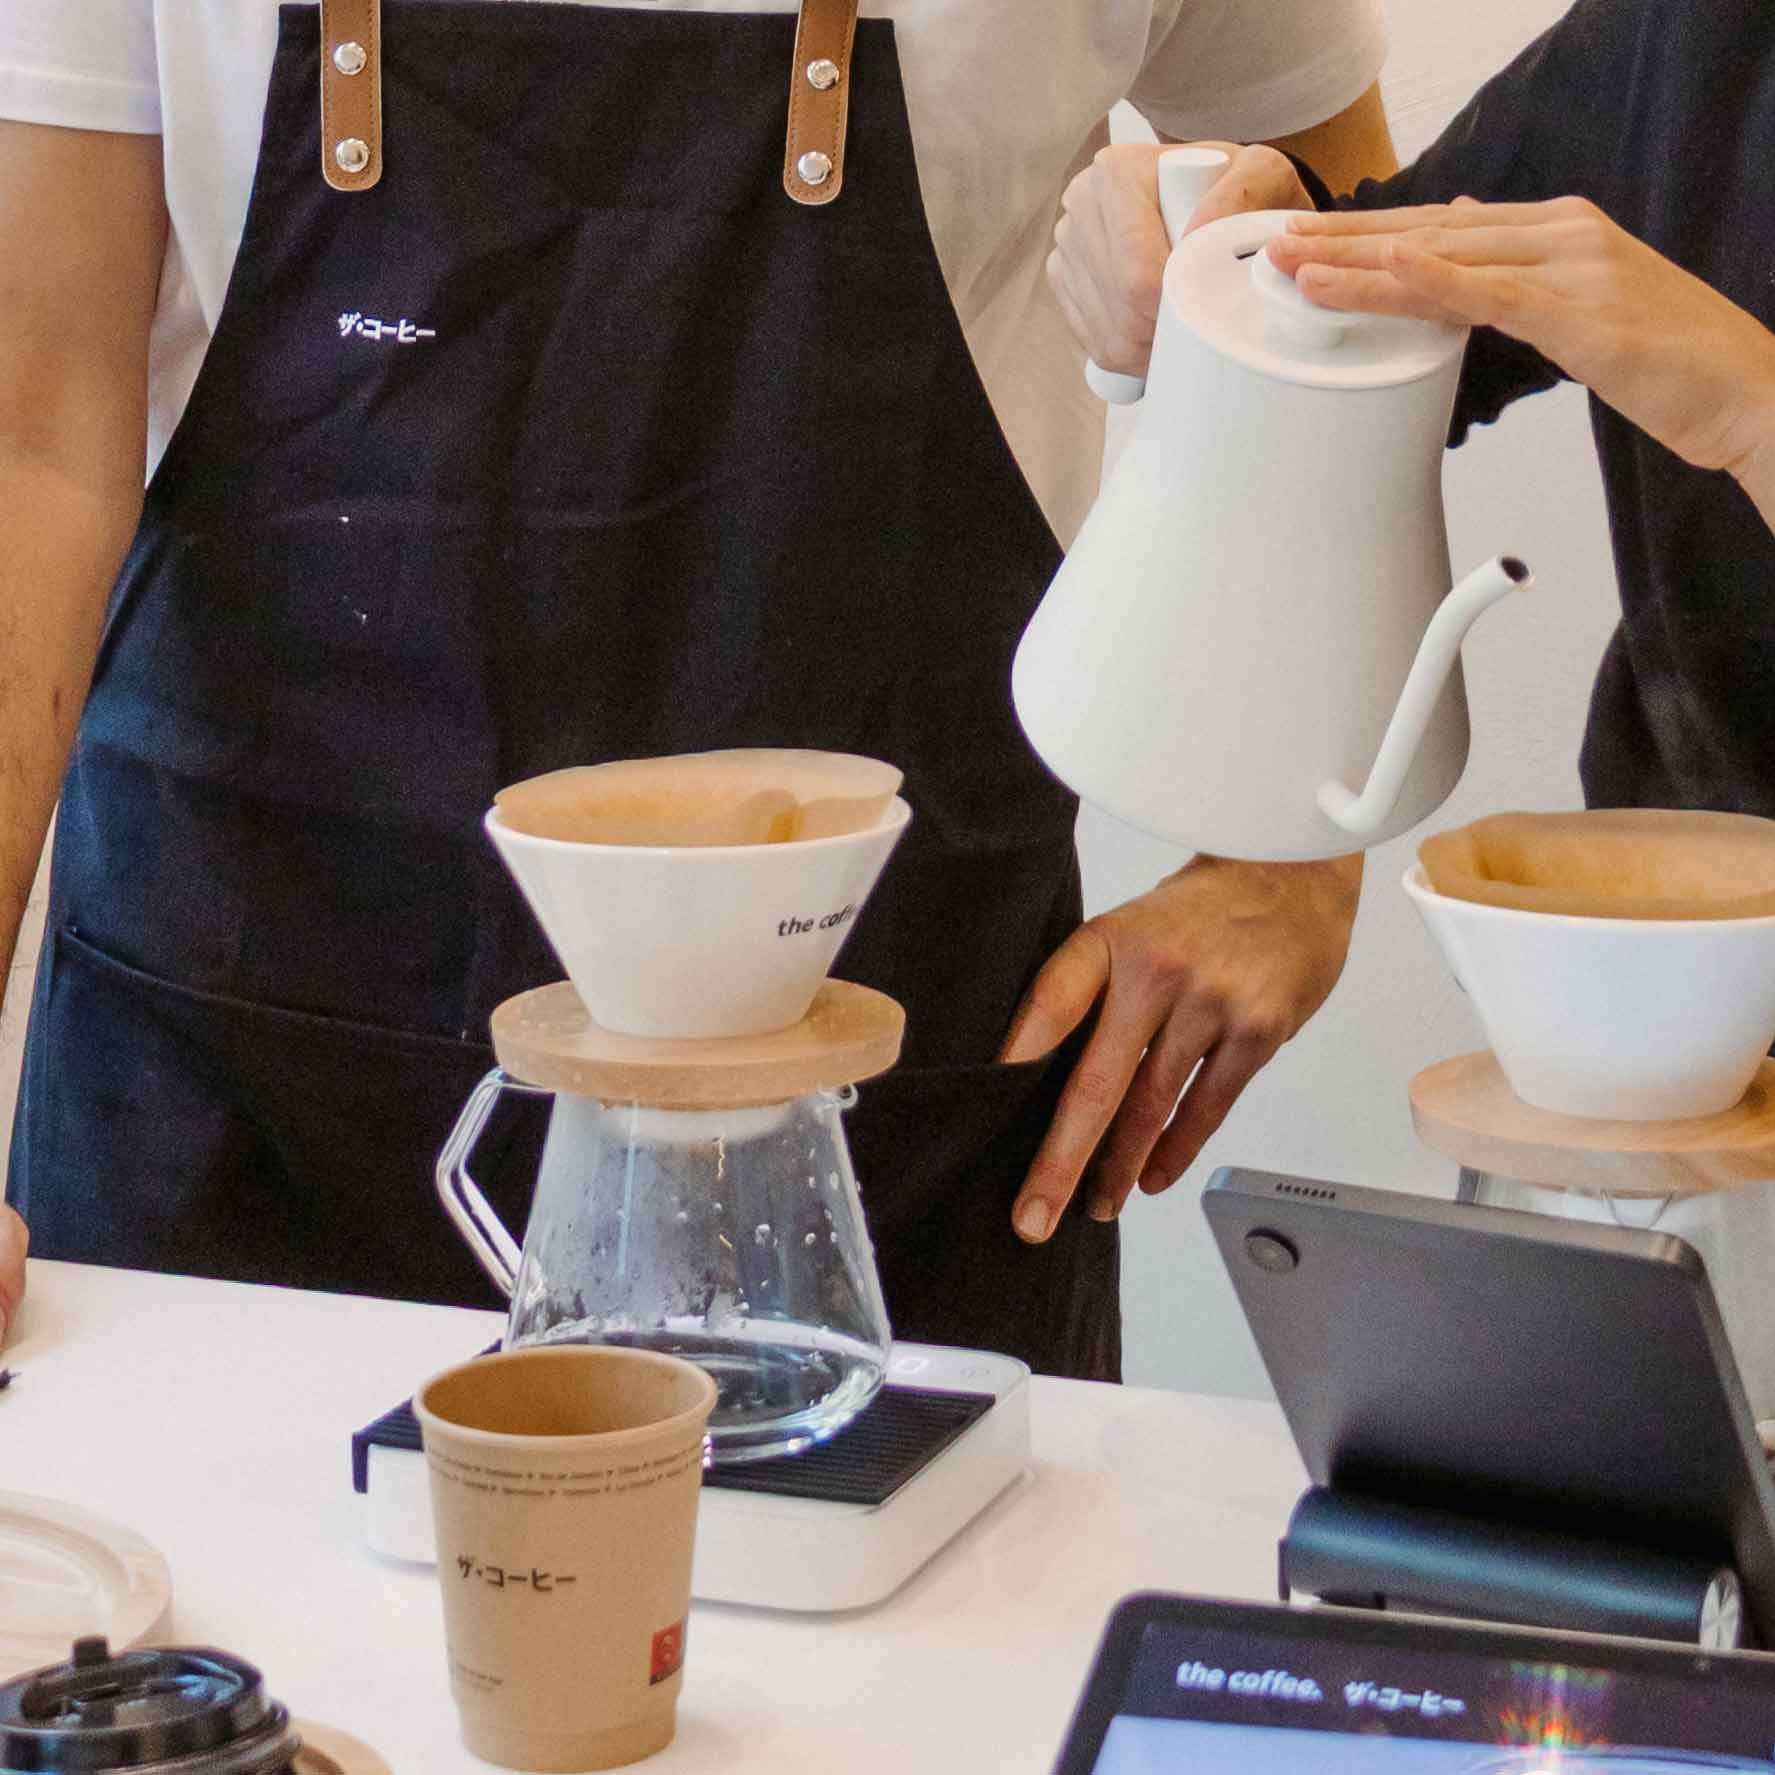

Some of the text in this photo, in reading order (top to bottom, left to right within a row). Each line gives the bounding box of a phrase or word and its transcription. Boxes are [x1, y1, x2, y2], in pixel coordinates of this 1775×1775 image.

[777, 916, 815, 937] the
[1176, 1660, 1226, 1692] the
[1227, 1669, 1324, 1705] coffee.
